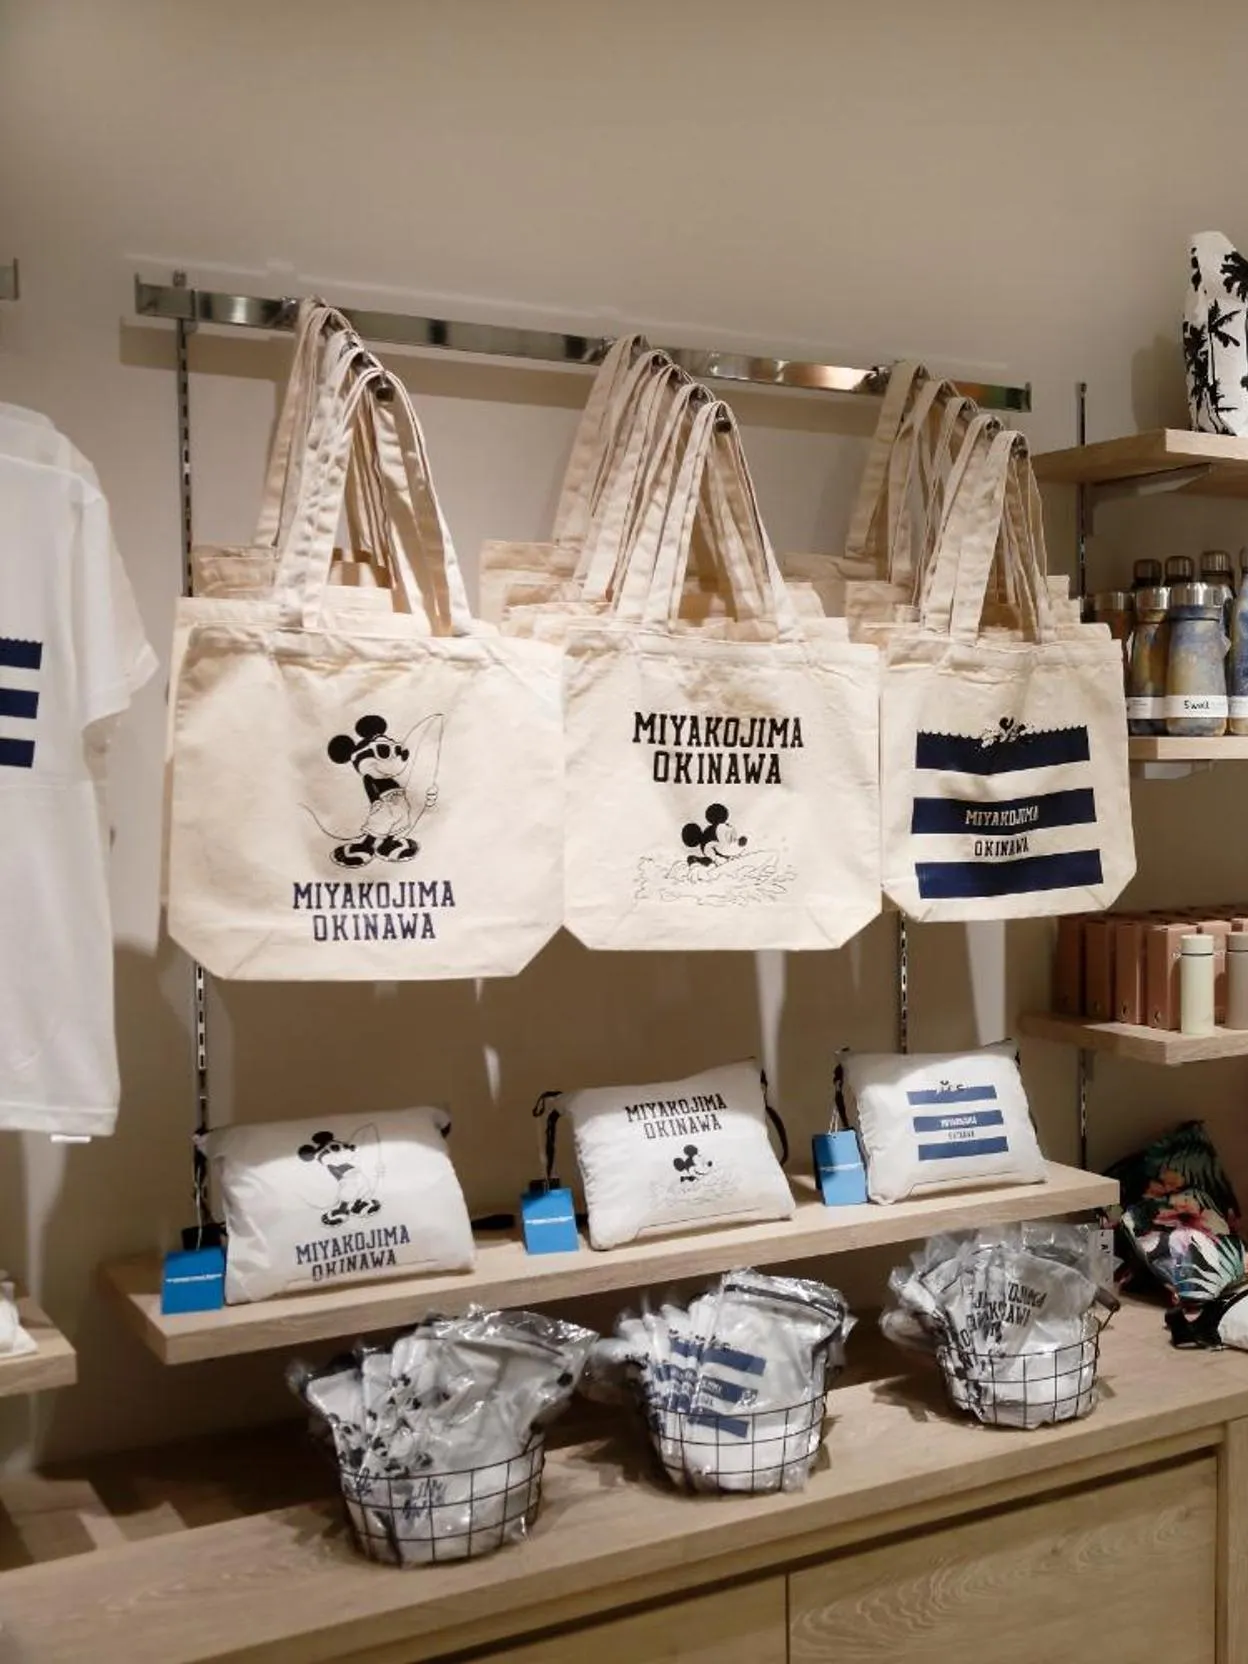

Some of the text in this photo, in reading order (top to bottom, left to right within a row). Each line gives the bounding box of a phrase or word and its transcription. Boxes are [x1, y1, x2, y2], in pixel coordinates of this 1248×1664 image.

[631, 711, 804, 749] MIYAKOJIMA
[652, 750, 783, 785] OKINAWA
[965, 805, 1039, 827] MIYAKOJIMA
[974, 836, 1029, 857] OKINAWA
[293, 880, 456, 909] MIYAKOJIMA
[312, 912, 437, 942] OKINAWA
[624, 1093, 727, 1123] MIYAKOJIMA
[643, 1114, 722, 1140] OKINAWA
[296, 1224, 411, 1266] MIYAKOJIMA
[312, 1249, 397, 1282] OKINAWA
